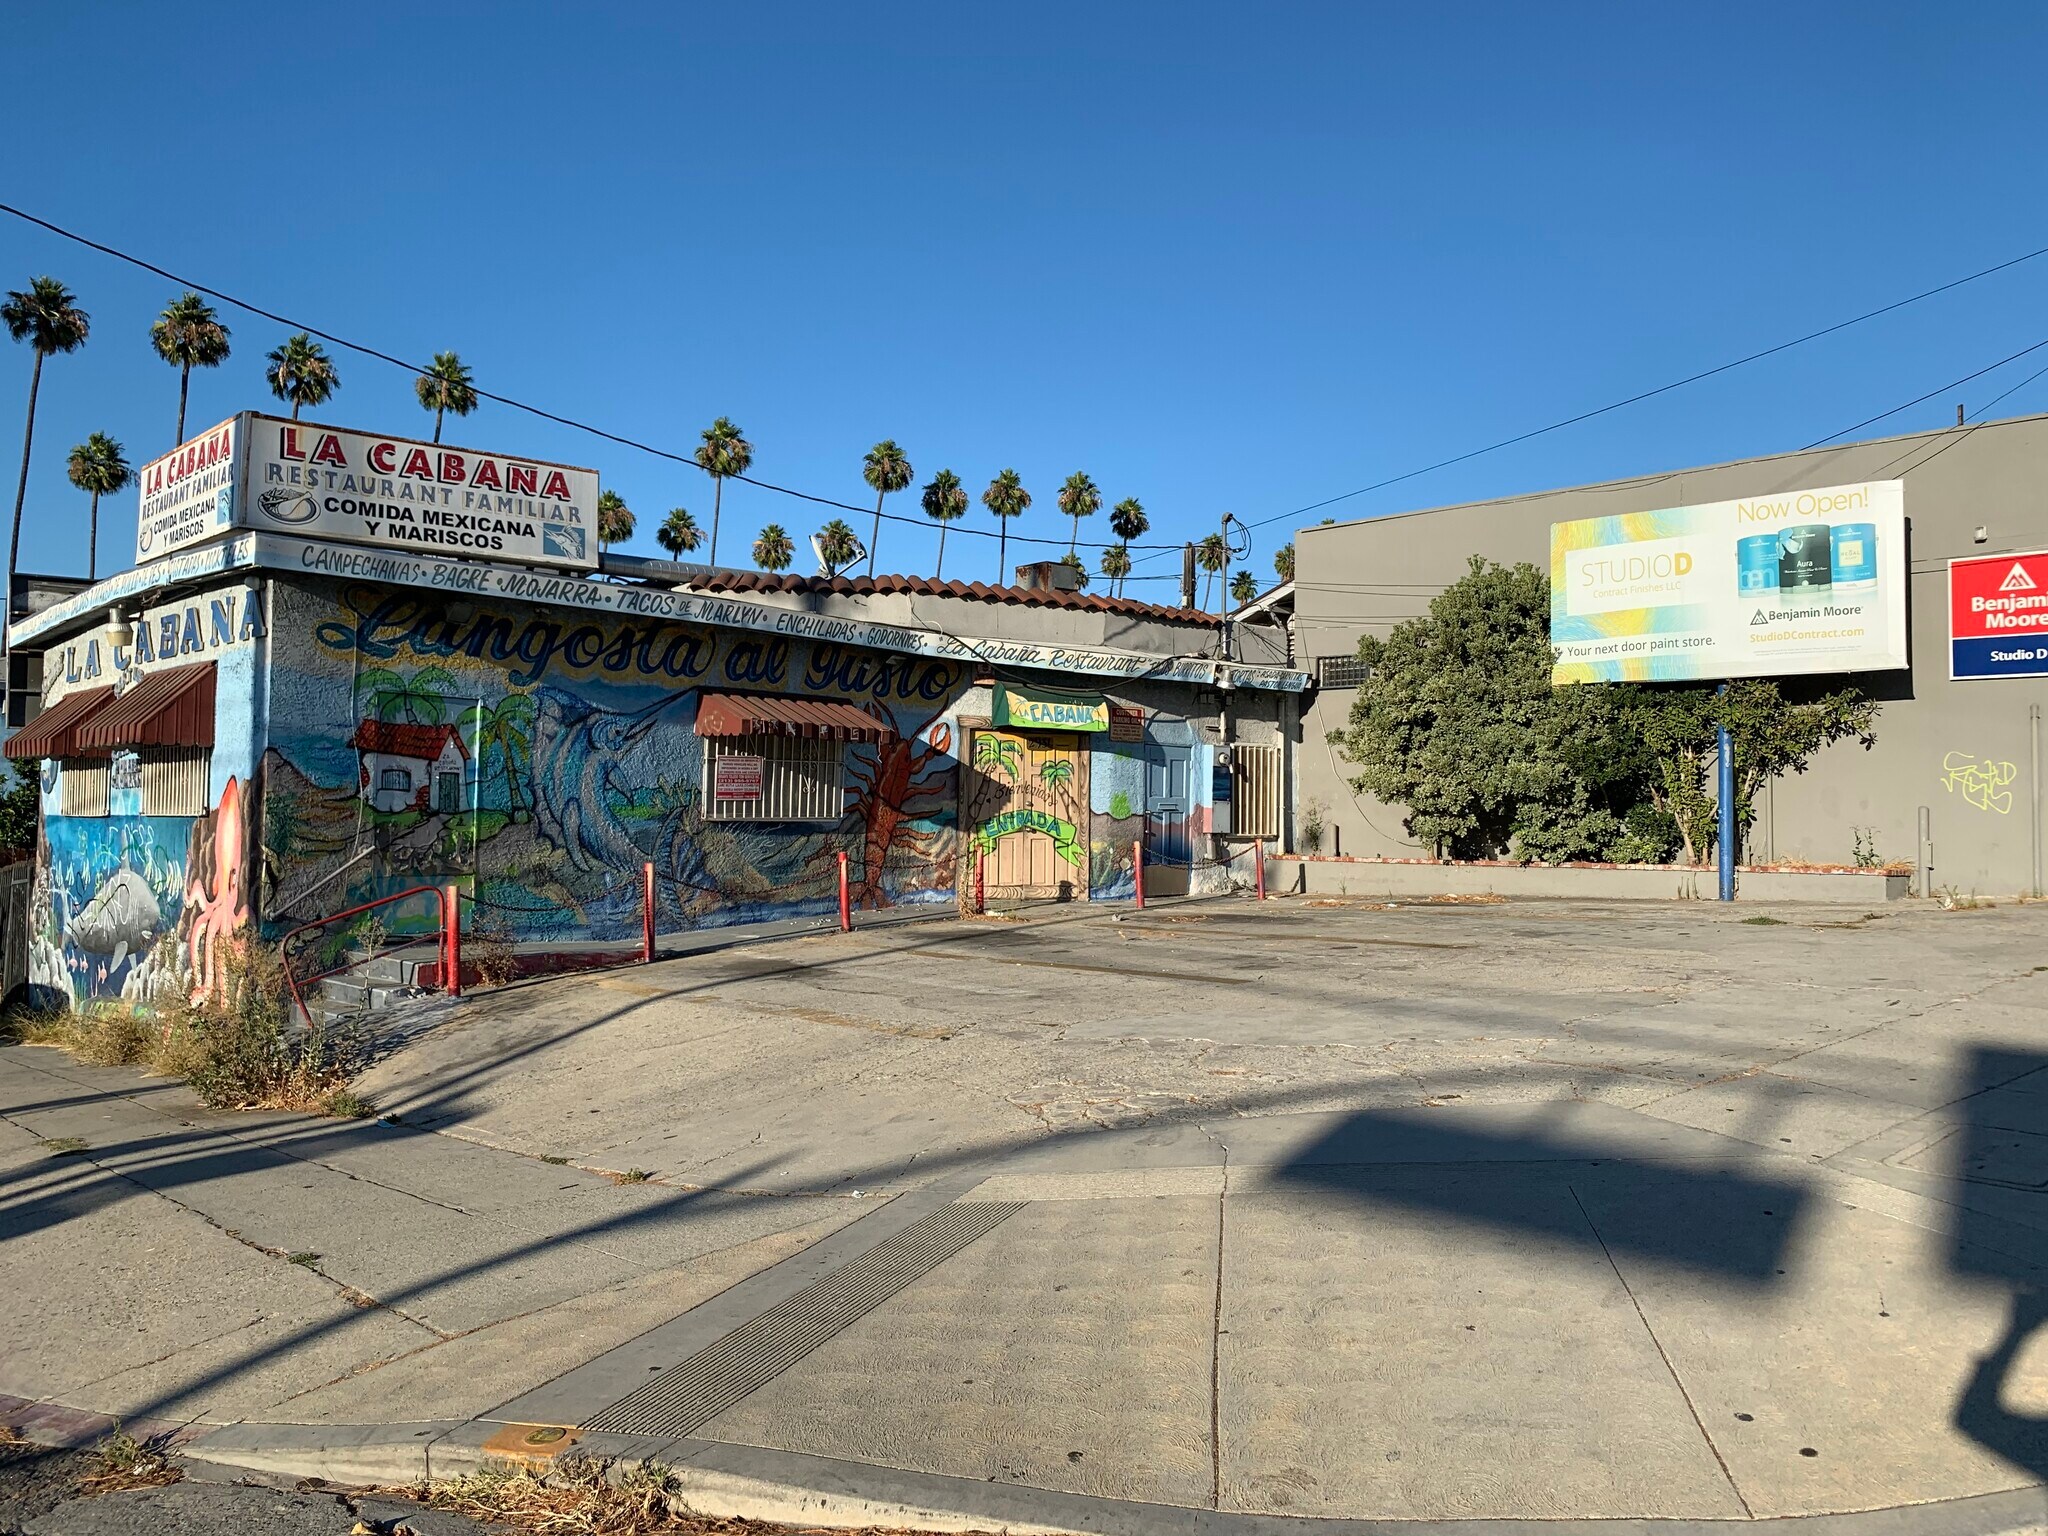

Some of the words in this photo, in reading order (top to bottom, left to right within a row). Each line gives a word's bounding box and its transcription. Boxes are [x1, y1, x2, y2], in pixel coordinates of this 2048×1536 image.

[280, 427, 347, 468] LA
[142, 482, 191, 521] RESTAURANT
[192, 462, 234, 498] FAMILIAR
[146, 465, 162, 499] LA
[265, 462, 452, 507] RESTAURANT
[462, 490, 581, 525] FAMILIAR
[154, 513, 178, 535] COMIDA
[178, 497, 215, 525] MEXICANA
[324, 497, 415, 523] COMIDA
[423, 510, 536, 538] MEXICANA
[1737, 502, 1788, 524] Now
[1796, 486, 1869, 520] Open!
[163, 533, 169, 547] Y
[169, 519, 204, 543] MARISCOS
[365, 520, 381, 536] Y
[389, 523, 503, 550] MARISCOS
[1797, 560, 1813, 568] Aura
[1593, 585, 1628, 598] Contract
[1630, 583, 1664, 594] Finishes
[1666, 581, 1681, 591] LLC
[302, 545, 420, 583] CAMPECHANAS
[431, 564, 493, 592] BAGRE
[501, 573, 601, 605] MOJARRA
[616, 590, 676, 616] TACOS
[678, 600, 692, 612] DE
[694, 600, 763, 626] MARLYN
[776, 613, 857, 642] ENCHILADAS
[970, 638, 1045, 664] Cabaña
[1173, 660, 1209, 680] BURRITOS
[1769, 608, 1820, 621] Benjamin
[1824, 606, 1862, 617] Moore
[66, 639, 101, 683] LA
[113, 589, 267, 671] CABANA
[317, 582, 716, 687] Langosta
[726, 636, 790, 685] al
[1567, 645, 1592, 657] Your
[1594, 643, 1618, 655] next
[1621, 639, 1647, 652] door
[1650, 637, 1679, 652] paint
[1682, 636, 1716, 648] store.
[1750, 627, 1865, 643] StudioDContract.com
[1990, 648, 2034, 662] Studio
[2036, 648, 2048, 659] D
[985, 812, 1062, 838] ENTRADA
